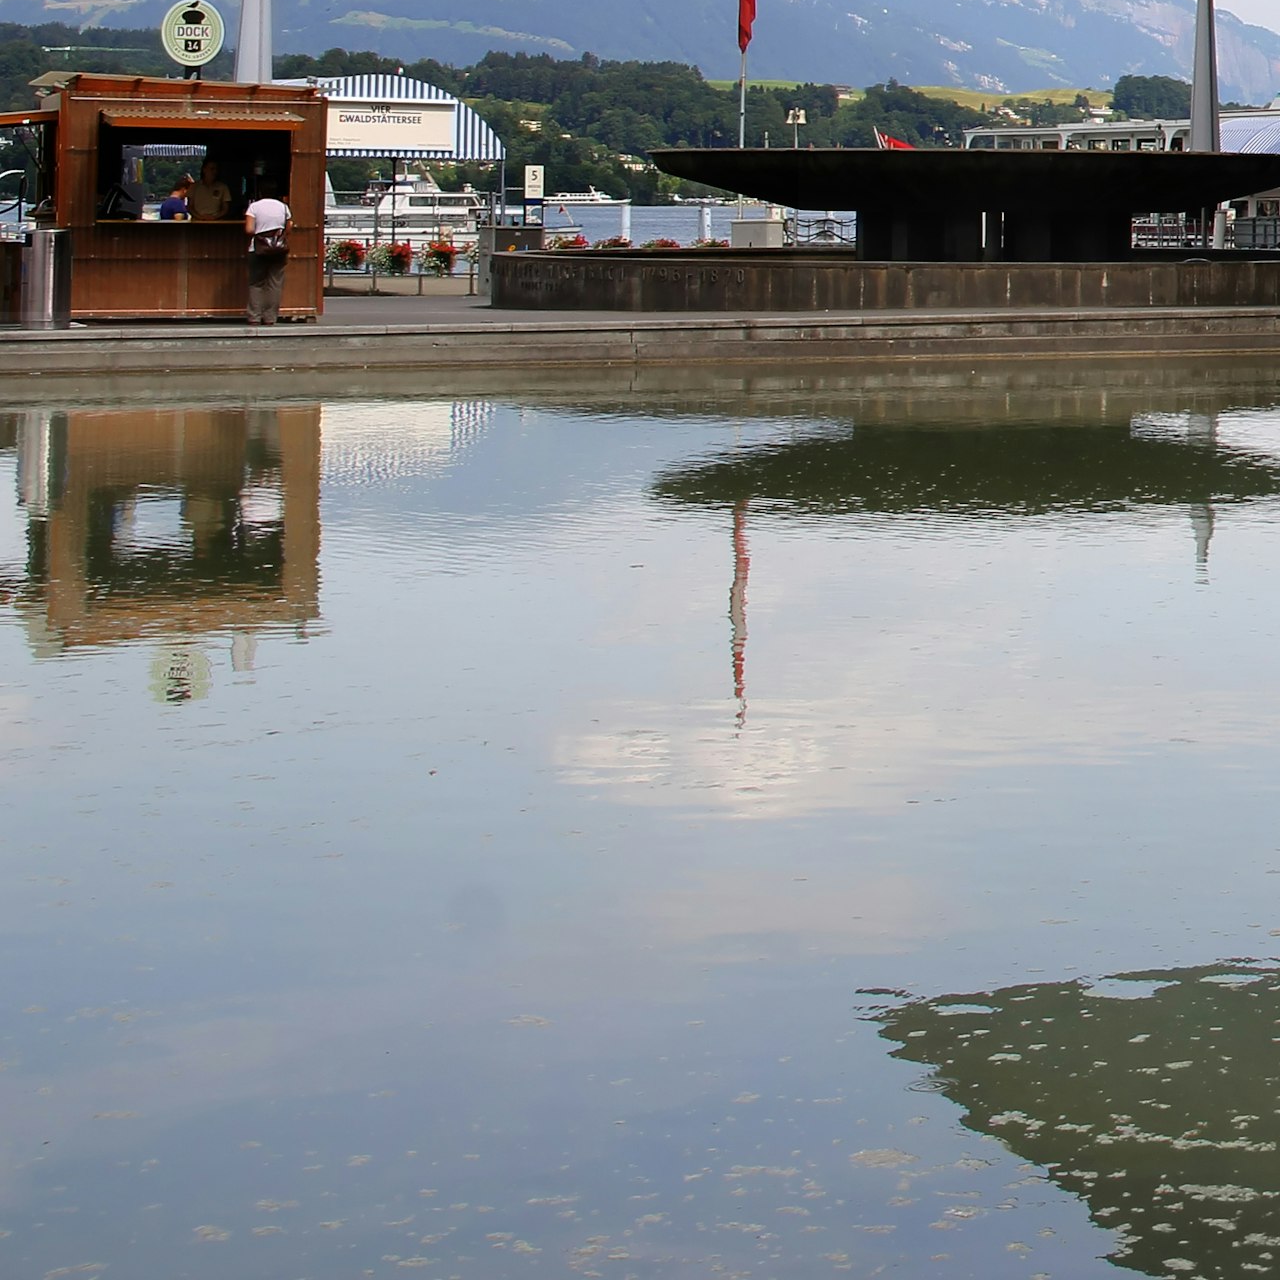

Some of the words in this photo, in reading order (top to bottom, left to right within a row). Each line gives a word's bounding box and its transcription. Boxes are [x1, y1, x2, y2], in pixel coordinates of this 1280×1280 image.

[177, 26, 210, 38] DOCK
[370, 105, 392, 114] VIER
[345, 114, 422, 124] WALDSTÄTTERSEE
[531, 170, 538, 181] 5
